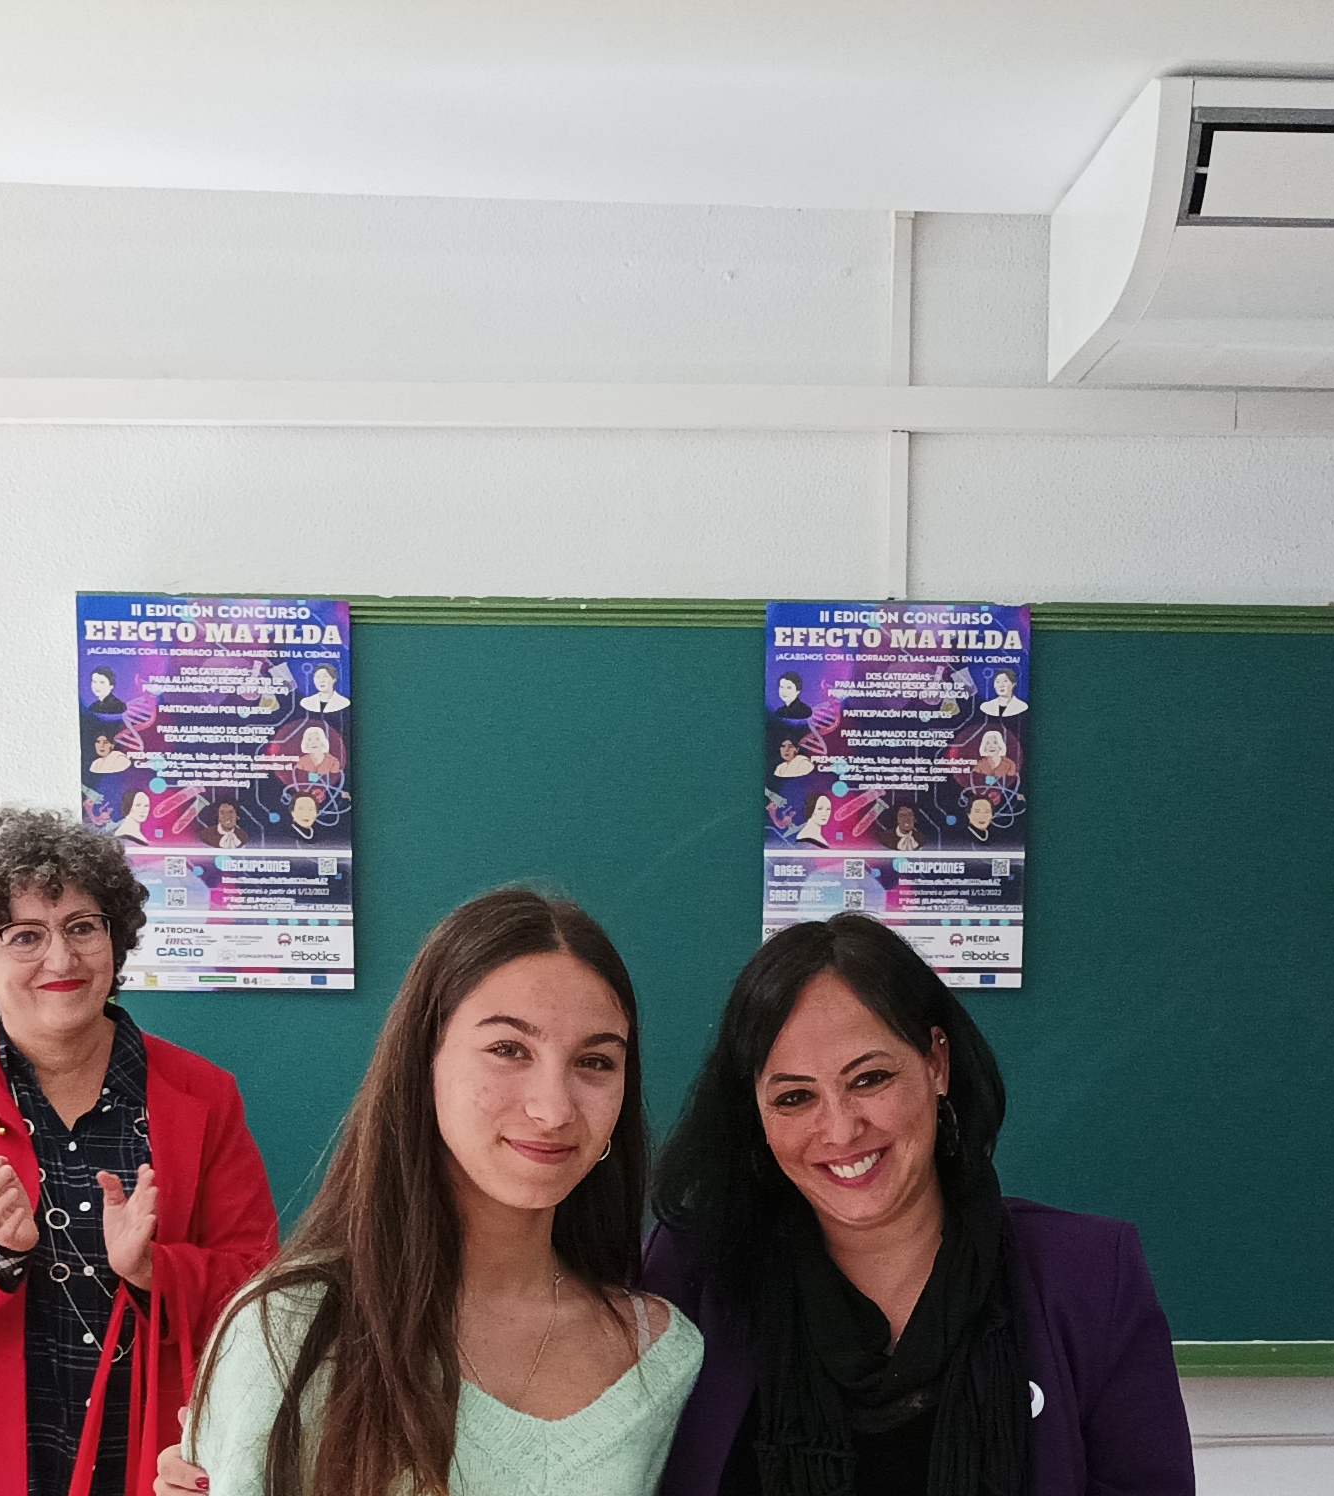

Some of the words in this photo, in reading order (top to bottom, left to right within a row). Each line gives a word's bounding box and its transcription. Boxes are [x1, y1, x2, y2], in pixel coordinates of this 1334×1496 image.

[131, 604, 141, 616] II
[146, 602, 213, 617] EDICIÓN
[218, 604, 310, 619] CONCURSO
[820, 610, 830, 622] II
[834, 608, 899, 623] EDICIÓN
[903, 611, 993, 625] CONCURSO
[84, 620, 197, 642] EFECTO
[205, 623, 342, 644] MATILDA
[774, 627, 882, 648] EFECTO
[890, 629, 1022, 650] MATILDA
[160, 648, 168, 656] EL
[926, 655, 960, 663] MUJERES
[866, 672, 882, 680] DOS
[835, 681, 856, 689] PARA
[843, 709, 900, 718] PARTICIPACIÓN
[898, 862, 965, 874] INSCRIPCIONES
[294, 935, 330, 943] MÉRIDA
[156, 947, 204, 957] CASIO
[291, 950, 341, 961] ebotics
[962, 951, 1009, 960] ebotics
